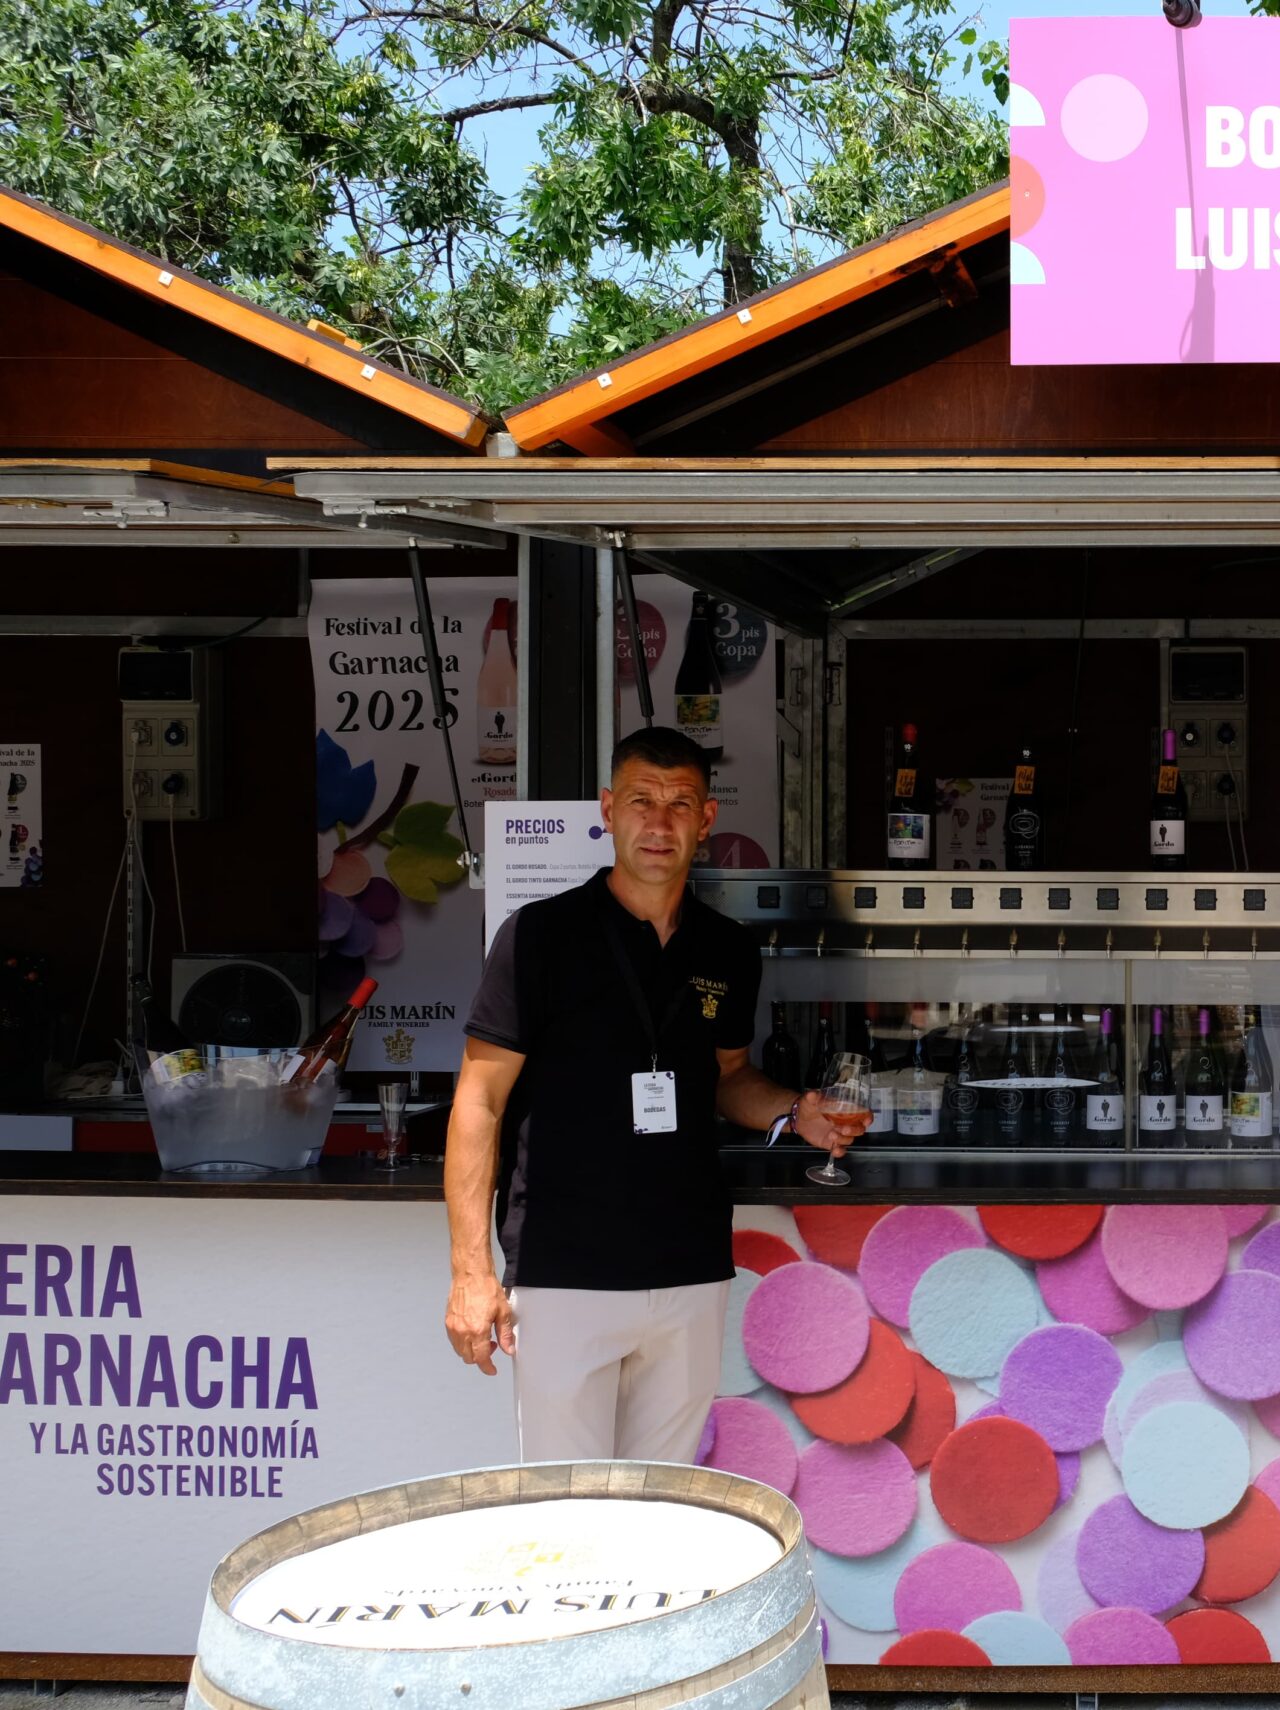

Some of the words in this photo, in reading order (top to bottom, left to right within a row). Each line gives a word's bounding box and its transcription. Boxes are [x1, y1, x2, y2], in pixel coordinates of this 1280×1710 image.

[324, 616, 402, 637] Festival
[443, 616, 463, 634] la
[713, 602, 740, 638] 3
[329, 651, 460, 675] Garnaca
[335, 688, 460, 732] 2025
[505, 819, 565, 834] PRECIOS
[505, 836, 516, 844] en
[518, 835, 549, 846] puntos
[390, 1001, 456, 1020] MARÍN
[29, 1422, 47, 1455] Y
[54, 1423, 89, 1456] LA
[97, 1419, 320, 1460] GASTRONOMÍA
[96, 1463, 284, 1499] SOSTENIBLE
[264, 1597, 531, 1630] MARÍN
[553, 1587, 721, 1614] LUIS
